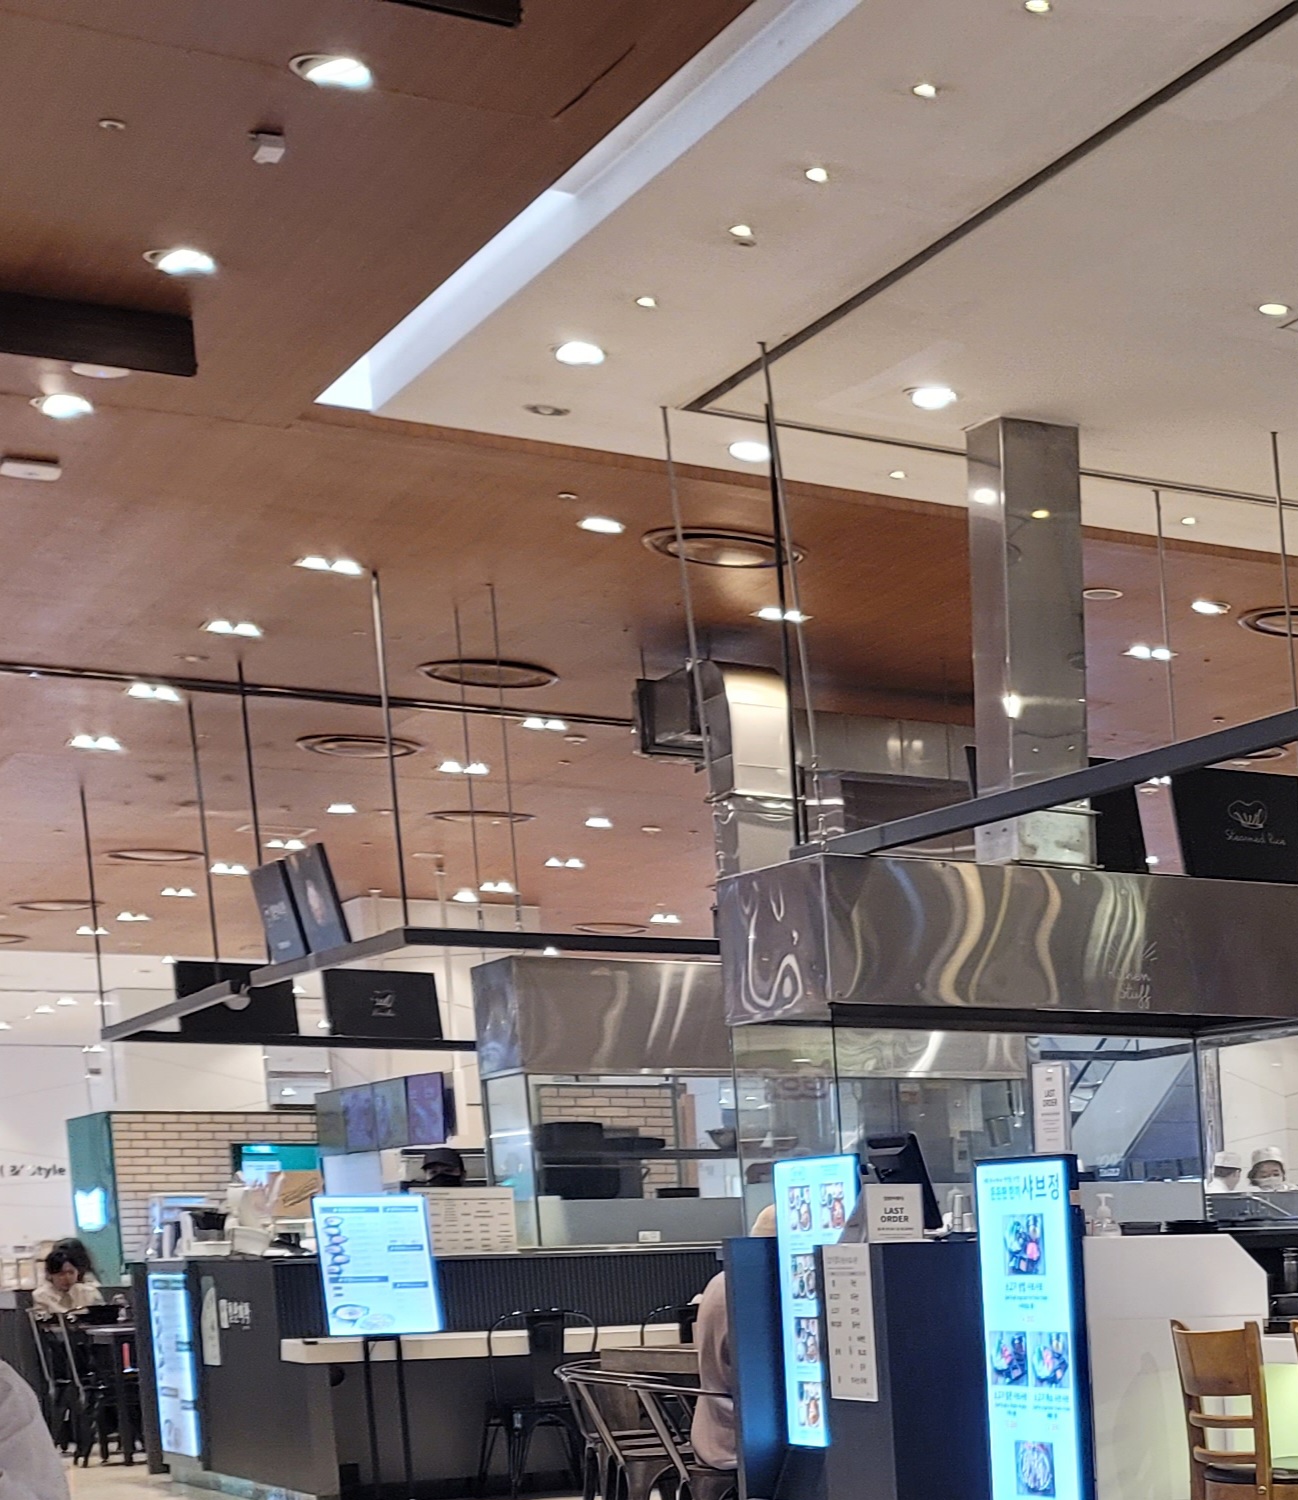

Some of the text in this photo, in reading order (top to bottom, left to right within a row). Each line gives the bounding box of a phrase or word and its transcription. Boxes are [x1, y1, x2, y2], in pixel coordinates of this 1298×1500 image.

[1022, 1172, 1060, 1201] 샤브정
[884, 1206, 905, 1215] LAST
[880, 1215, 909, 1224] ORDER
